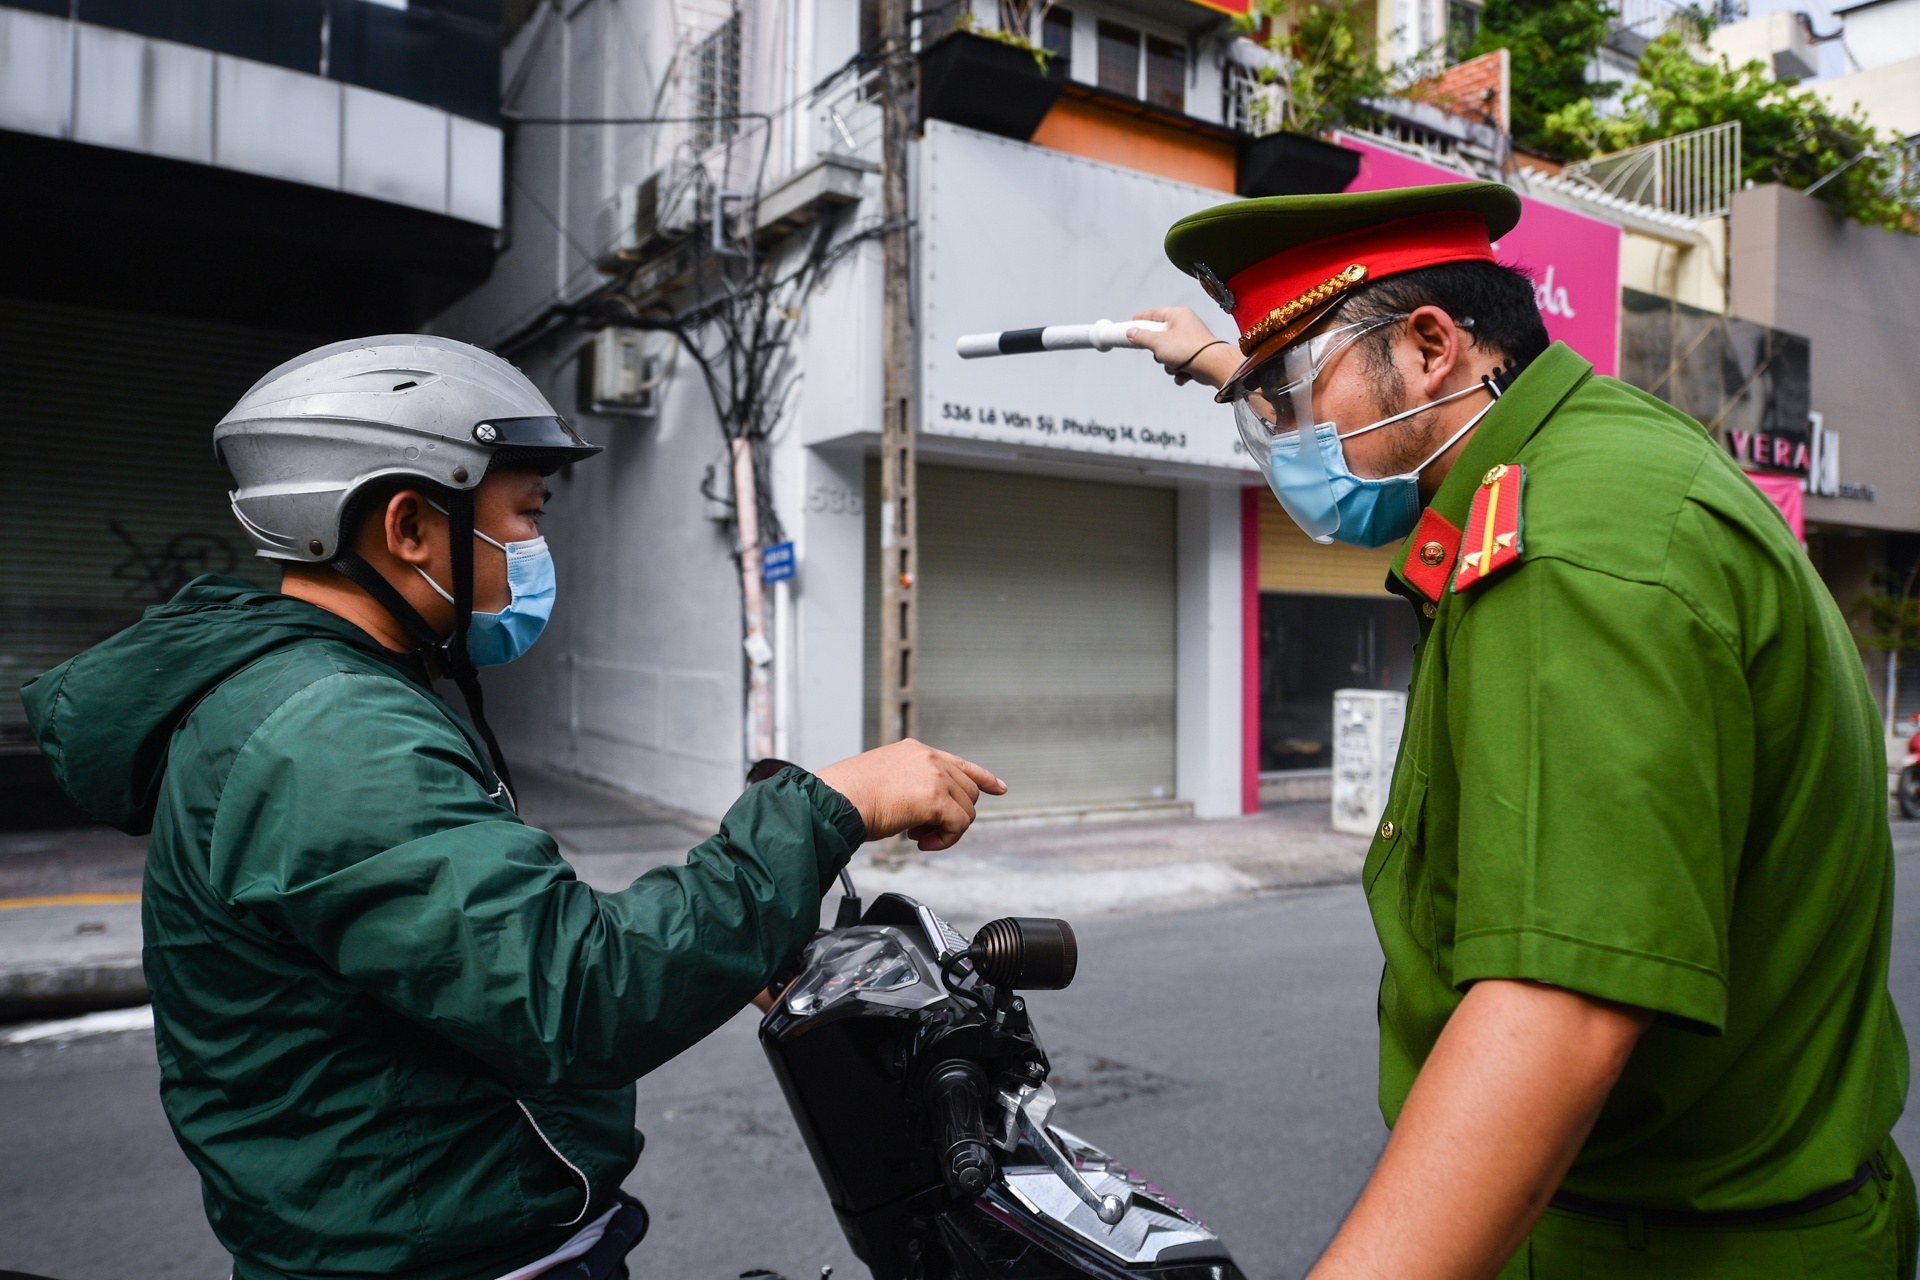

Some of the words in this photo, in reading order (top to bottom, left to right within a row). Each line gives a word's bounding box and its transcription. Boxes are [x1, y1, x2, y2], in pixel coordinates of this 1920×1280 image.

[1533, 265, 1575, 318] da
[943, 402, 972, 421] 536
[979, 407, 996, 425] Lê
[1120, 425, 1138, 444] 14,
[1730, 427, 1811, 471] VERA
